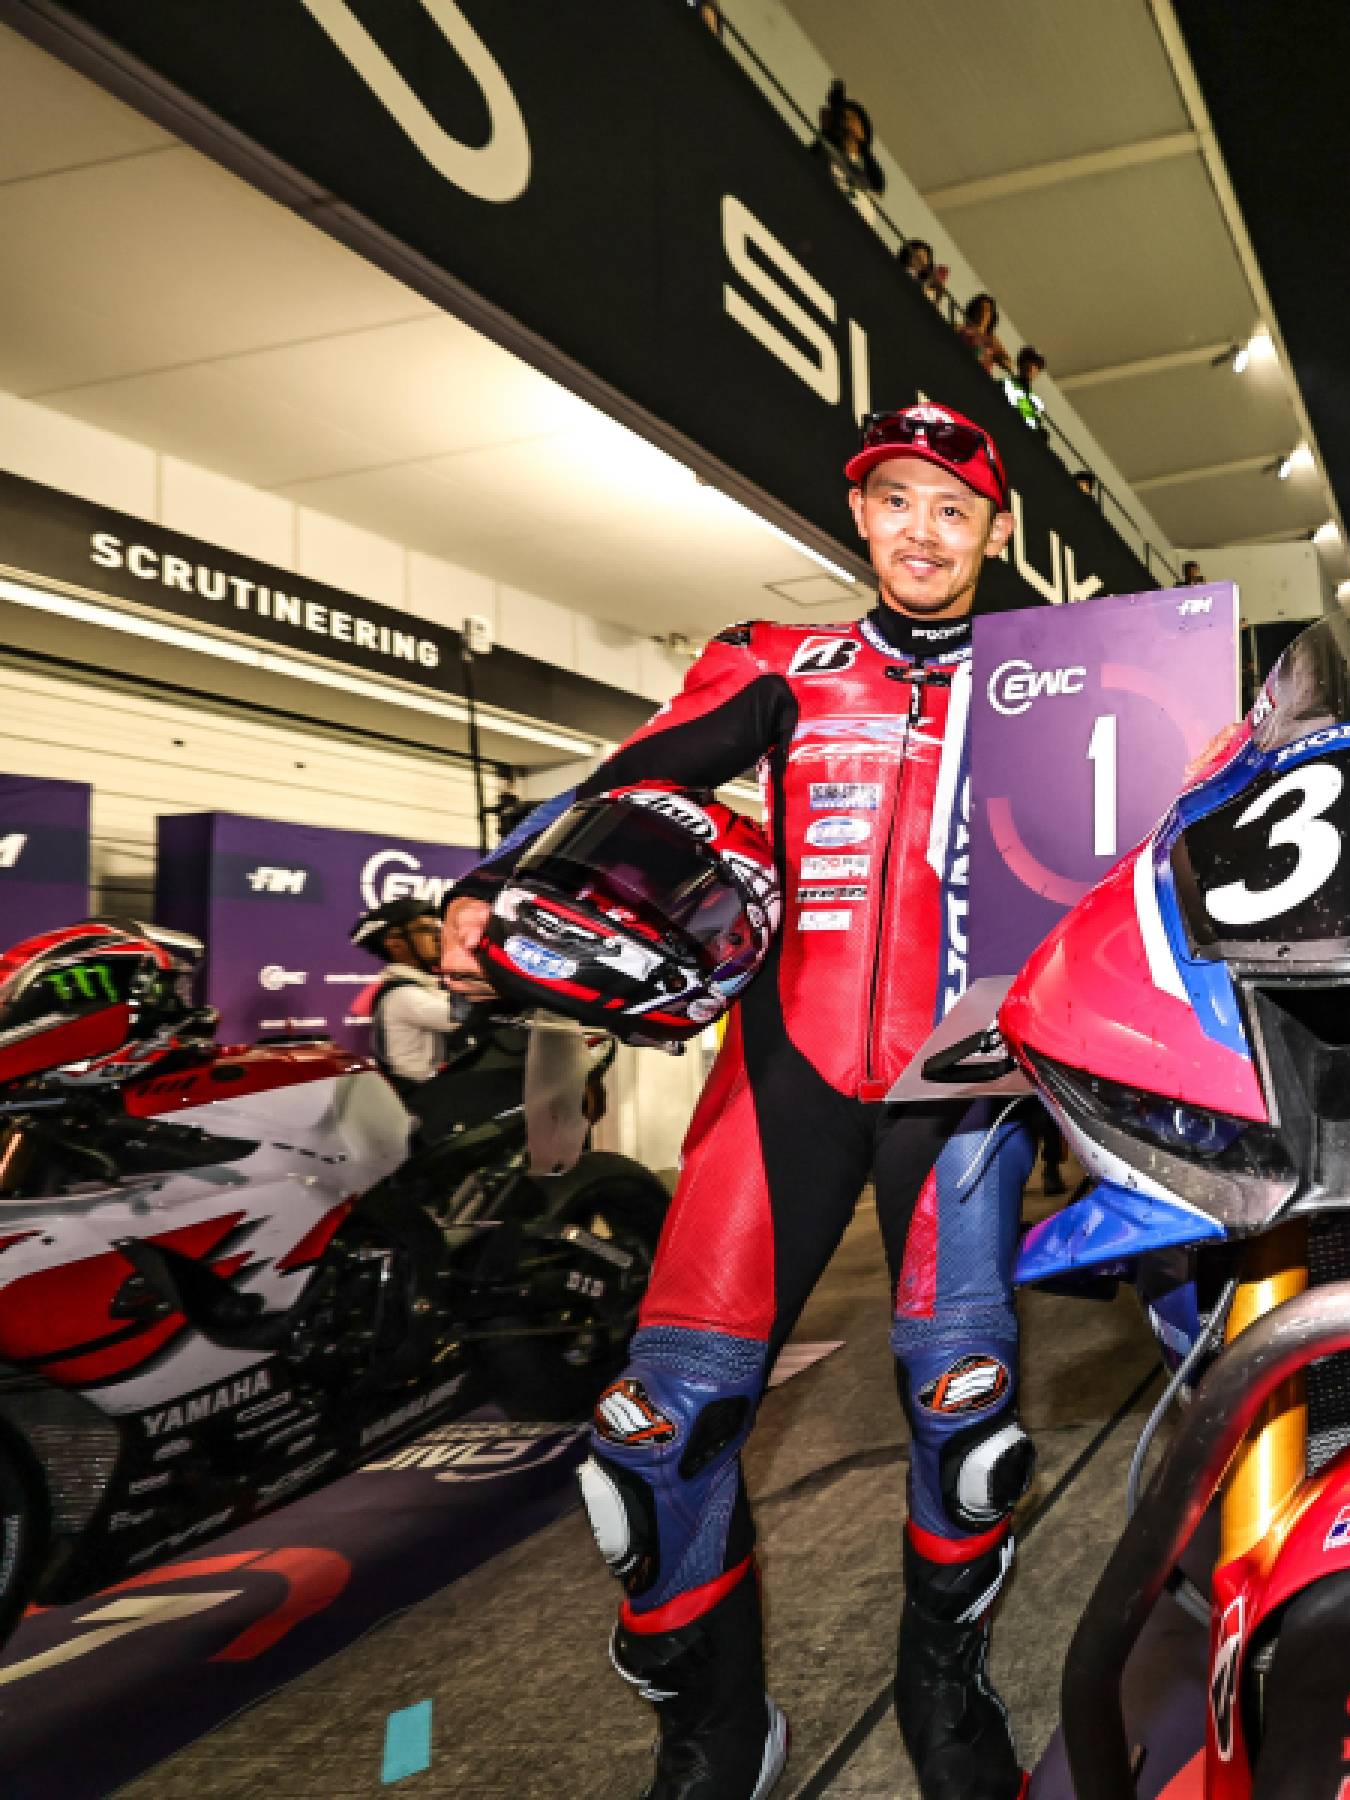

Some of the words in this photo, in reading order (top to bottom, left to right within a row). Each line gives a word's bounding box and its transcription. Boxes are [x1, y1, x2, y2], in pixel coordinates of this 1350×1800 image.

[90, 532, 440, 668] SCRUTINEERING
[1003, 667, 1087, 700] EWC
[1085, 715, 1117, 856] 1
[142, 1368, 272, 1437] YAMAHA
